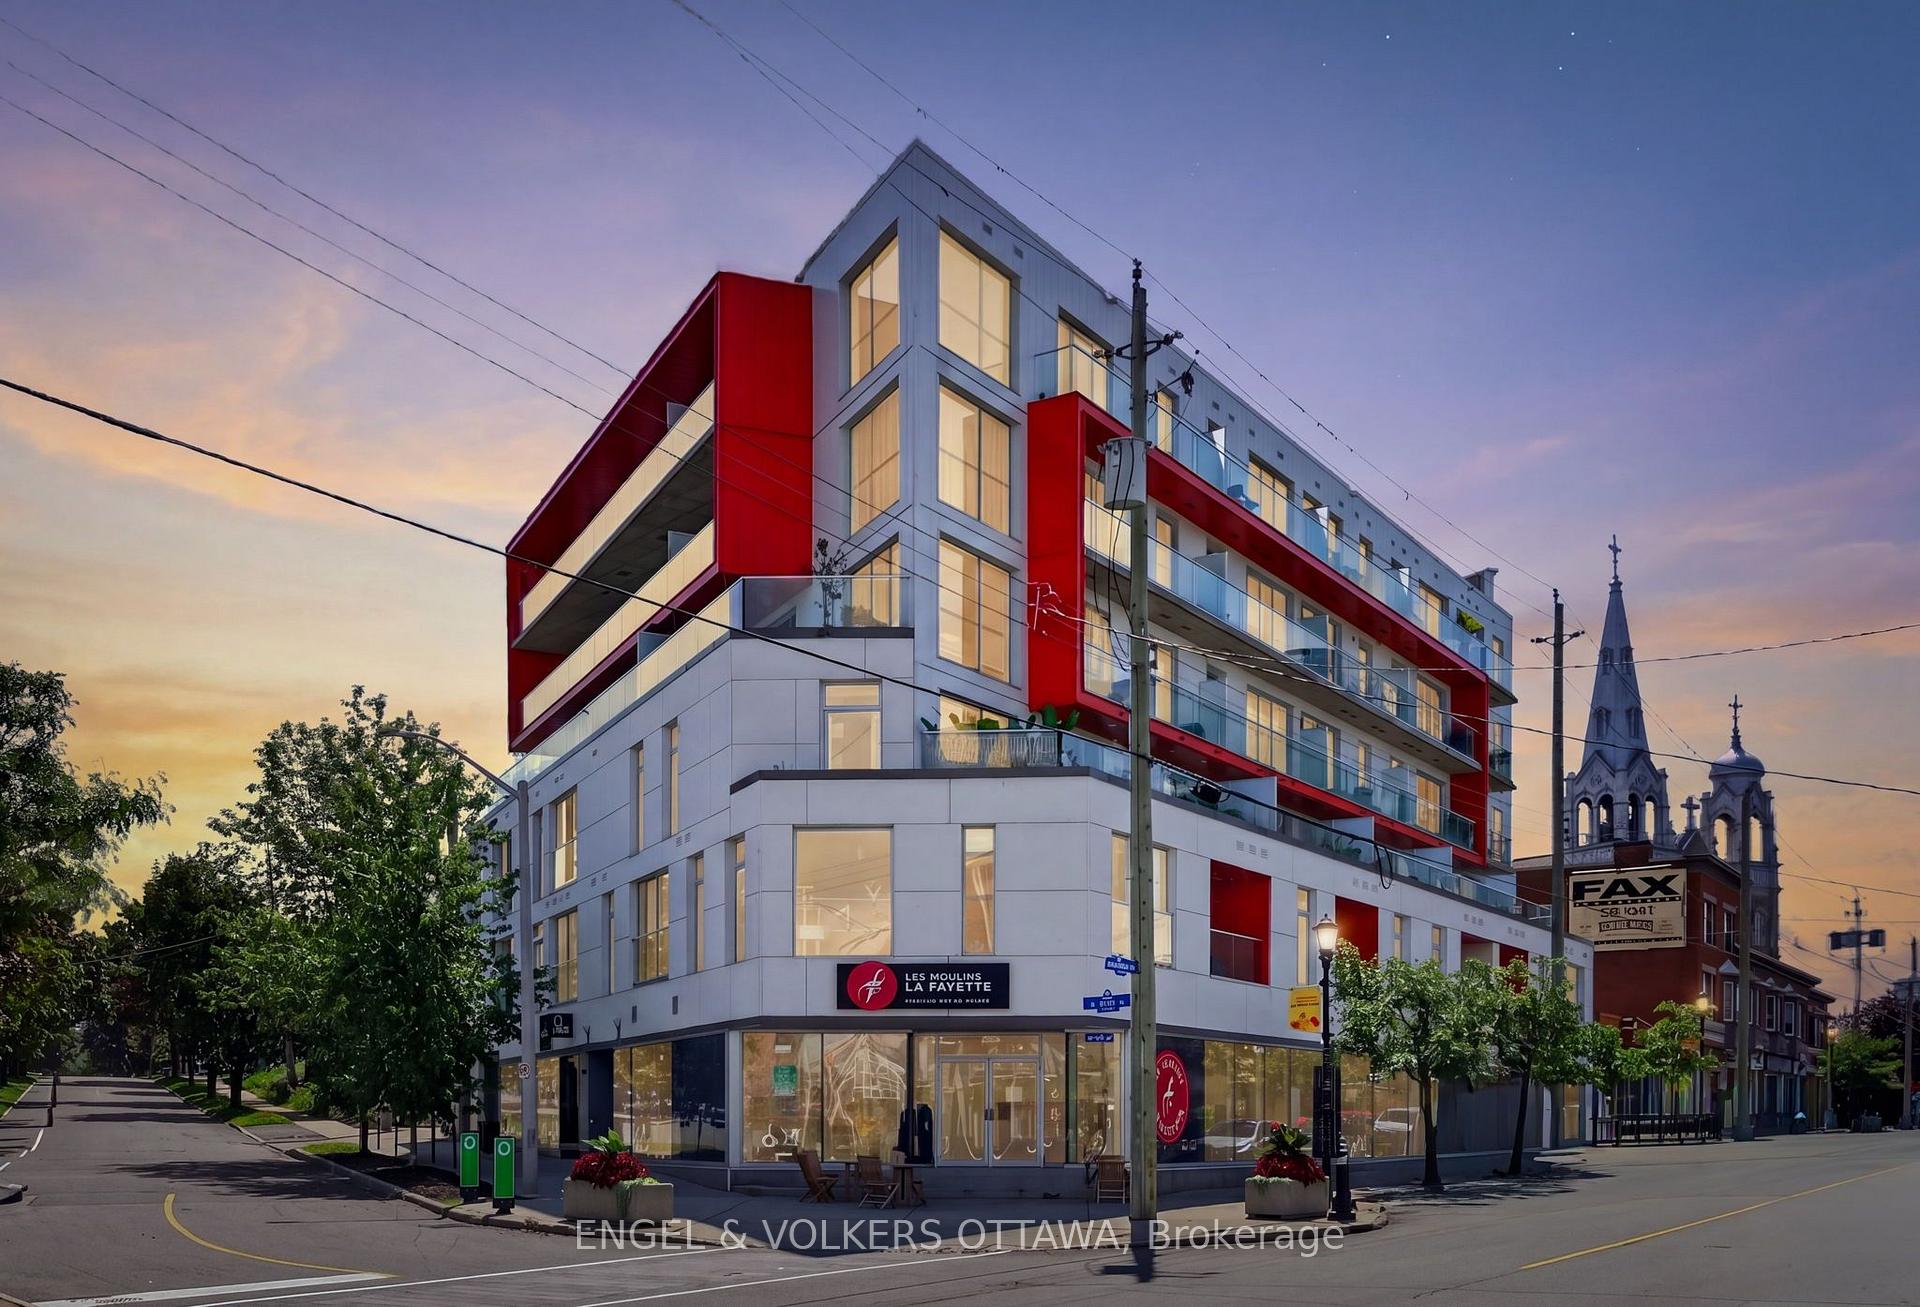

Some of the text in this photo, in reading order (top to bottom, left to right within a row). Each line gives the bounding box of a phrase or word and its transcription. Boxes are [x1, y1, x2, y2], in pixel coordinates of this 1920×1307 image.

[1573, 874, 1680, 901] FAX
[905, 973, 982, 981] LES MOULINS
[905, 982, 992, 992] LA FAYETTE
